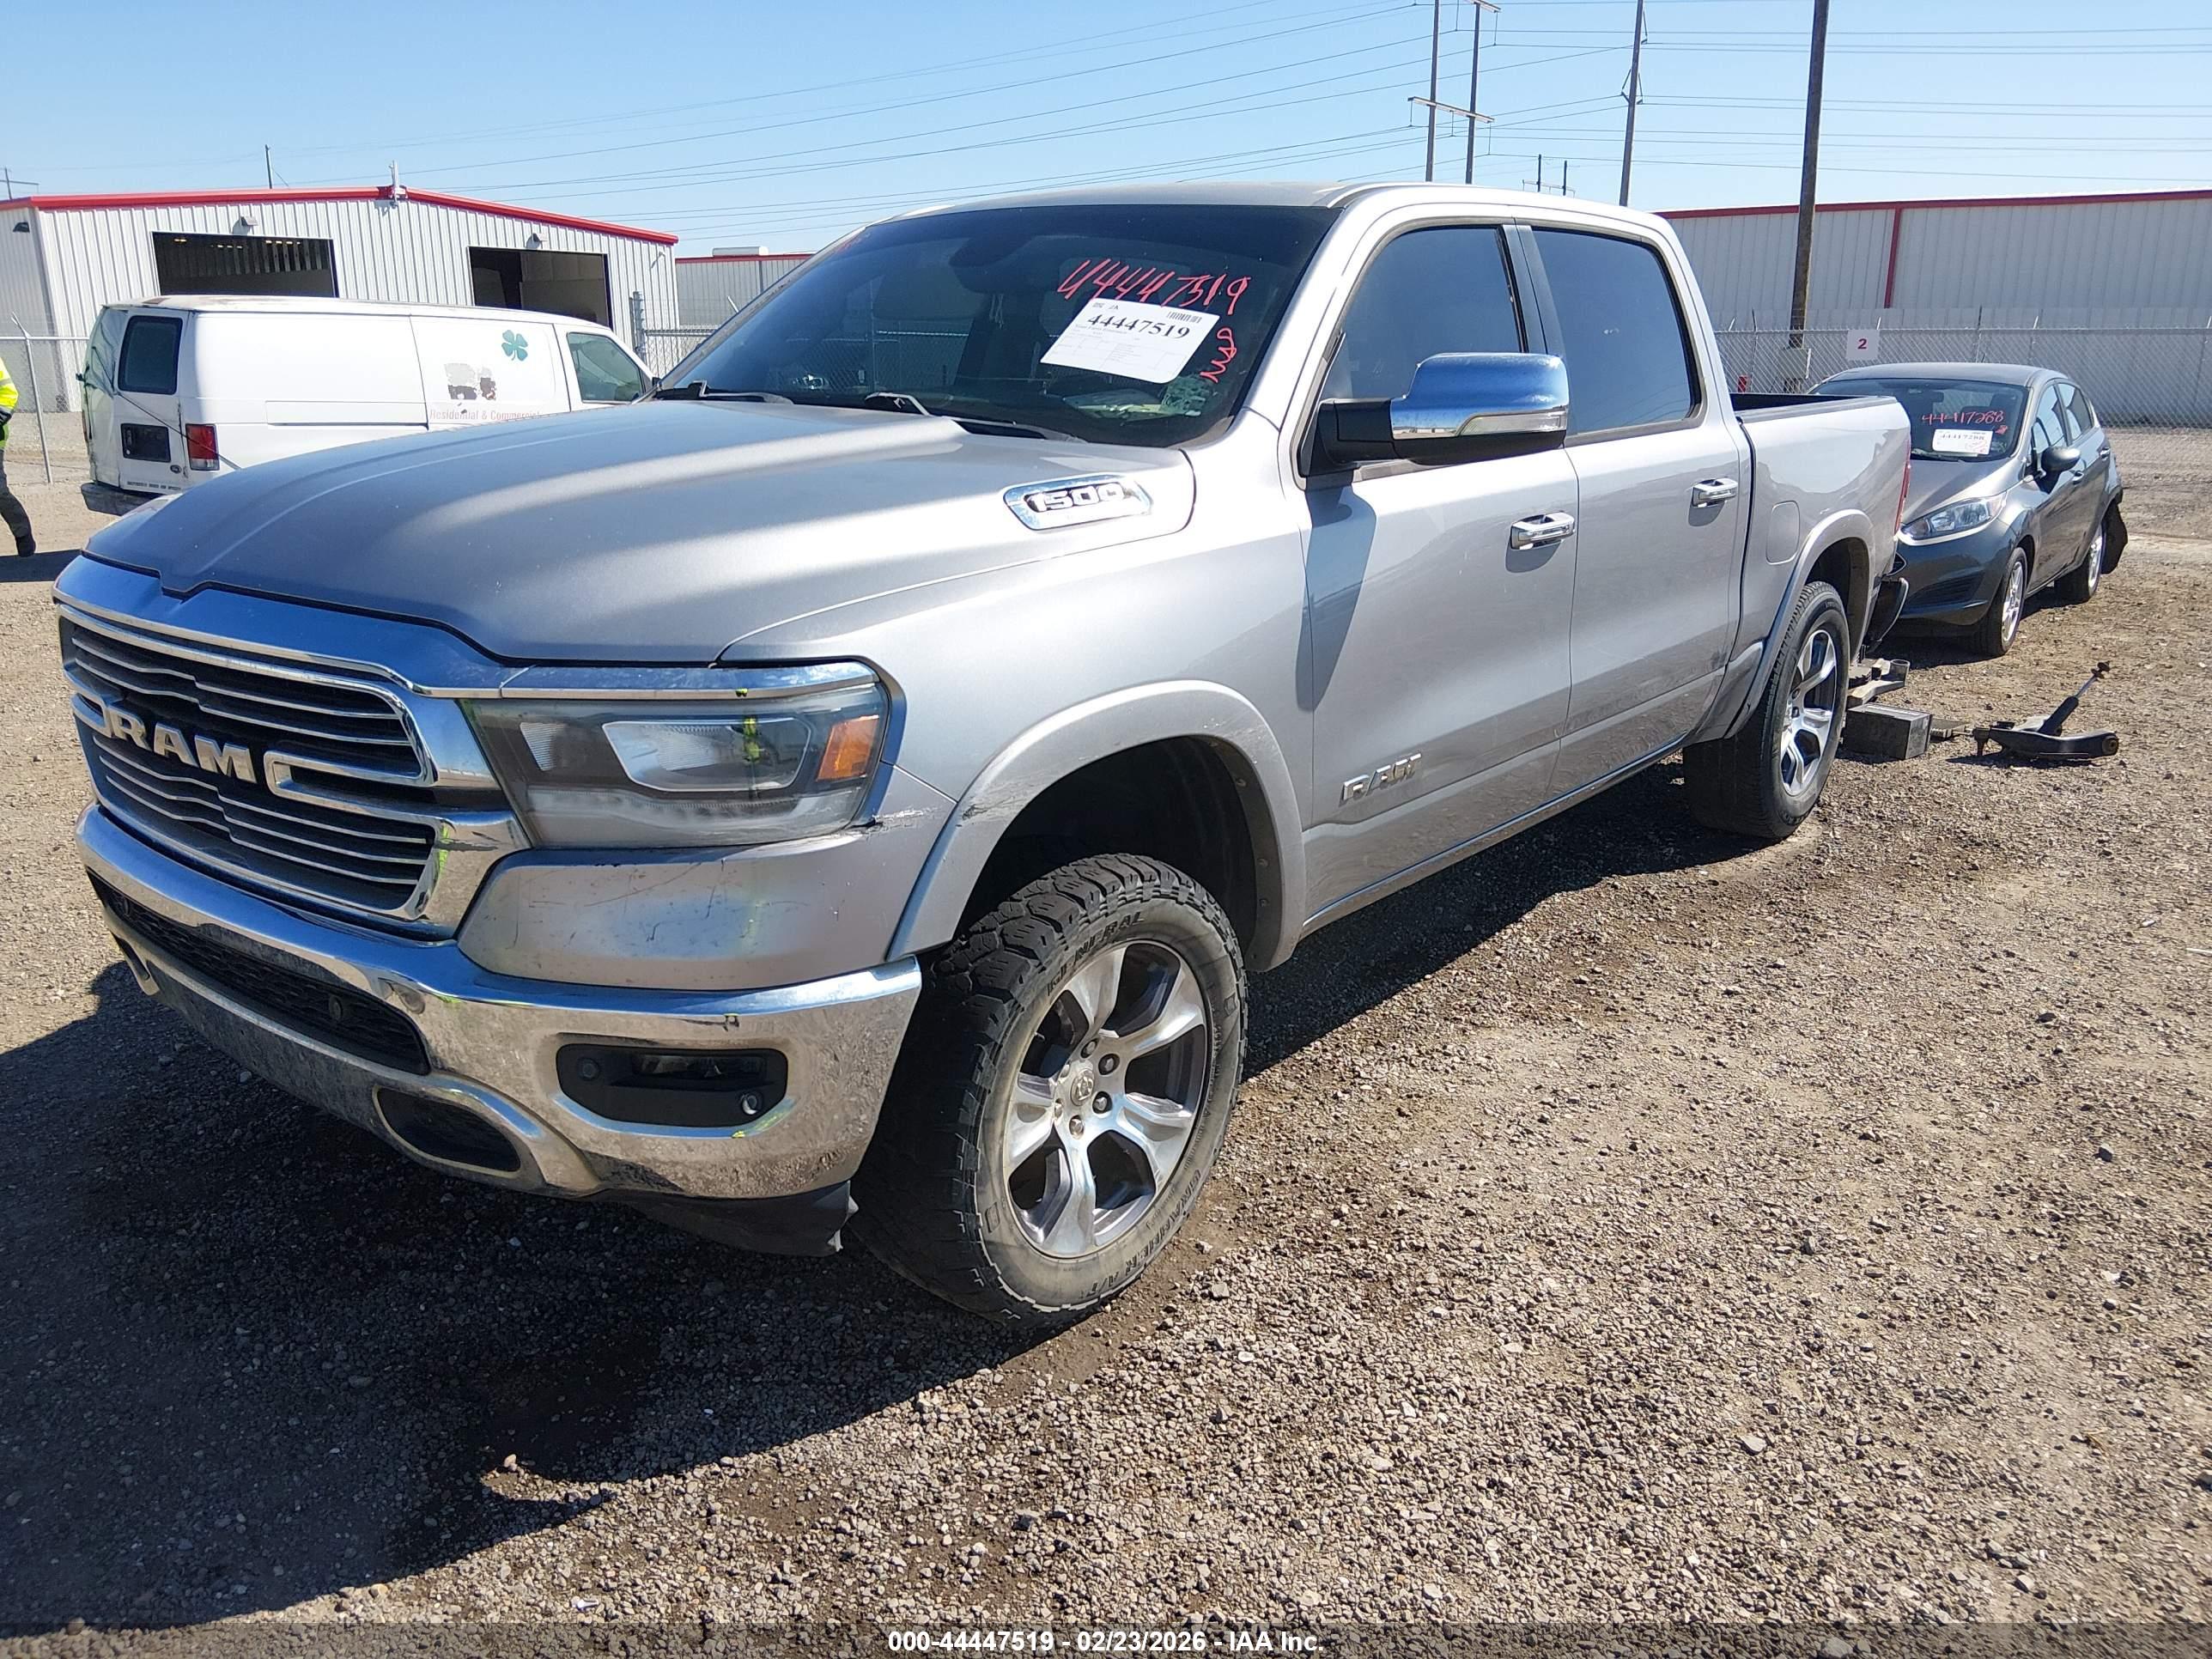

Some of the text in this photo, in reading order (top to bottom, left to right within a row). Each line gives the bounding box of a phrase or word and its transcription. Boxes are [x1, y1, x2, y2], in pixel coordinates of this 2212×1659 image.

[1087, 314, 1190, 338] 44447519
[1857, 337, 1868, 349] 2
[481, 410, 488, 420] &
[1024, 481, 1124, 513] 1500
[106, 704, 258, 785] RAM
[1340, 753, 1422, 805] RAM
